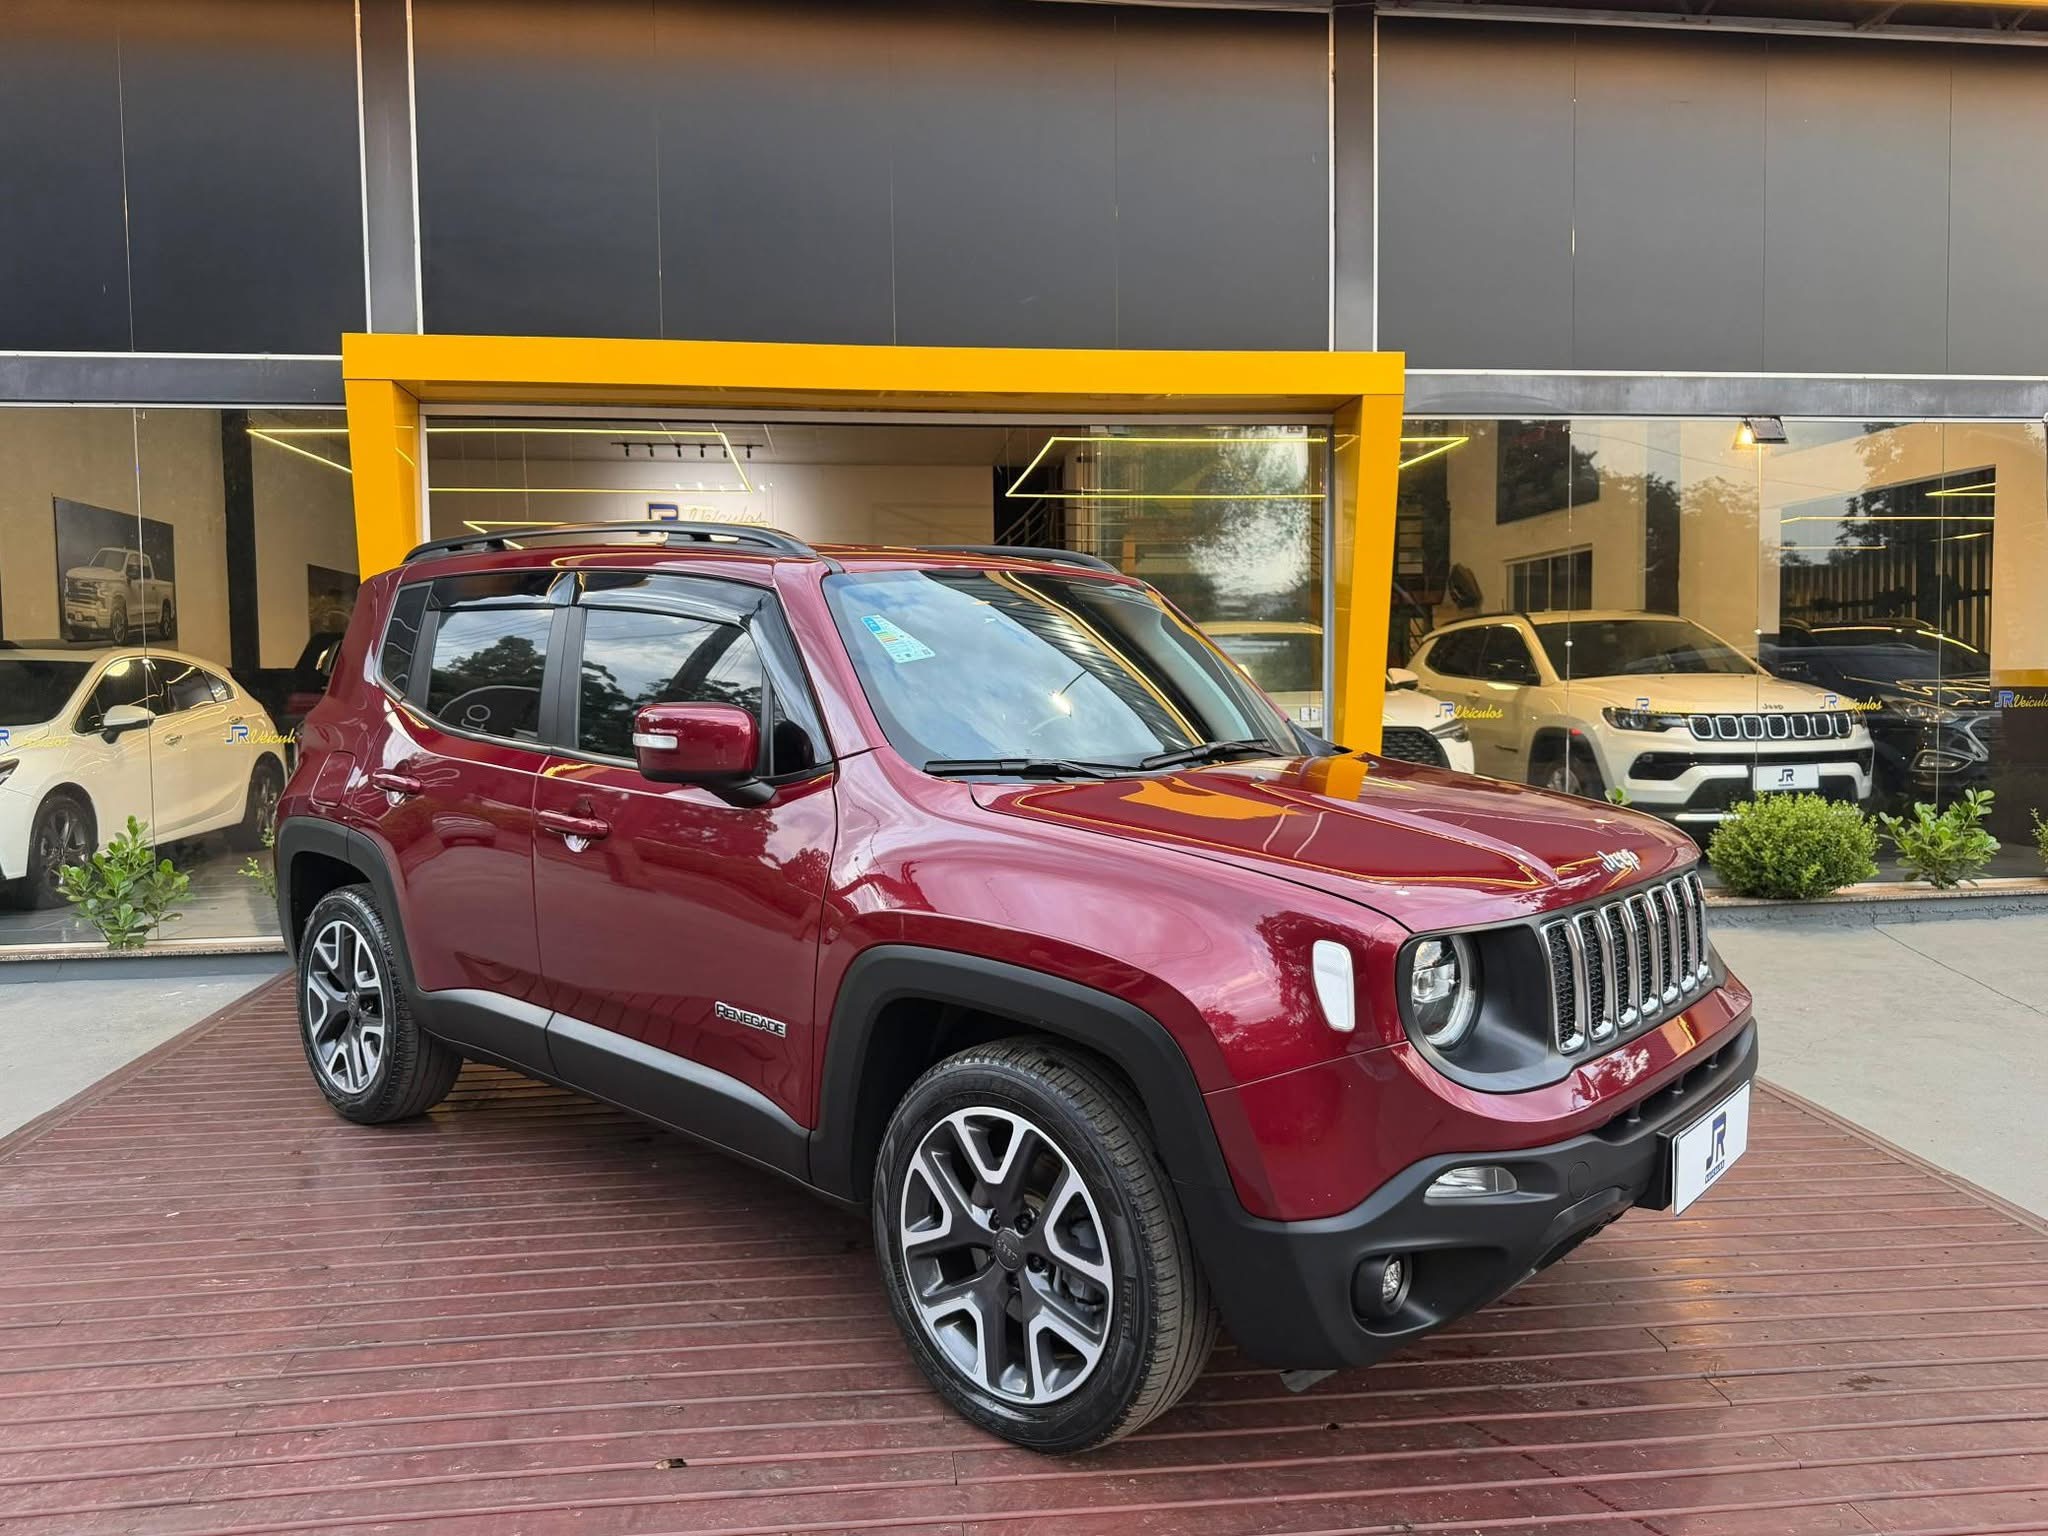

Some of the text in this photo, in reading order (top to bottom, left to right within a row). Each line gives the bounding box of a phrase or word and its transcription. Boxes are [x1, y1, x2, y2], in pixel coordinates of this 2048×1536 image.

[1819, 693, 1838, 709] JR
[1995, 690, 2014, 707] JR
[1435, 701, 1454, 719] JR
[225, 725, 249, 744] JR
[1778, 768, 1794, 782] JR
[1596, 848, 1641, 874] Jeep
[715, 1001, 787, 1038] RENEGADE
[1705, 1111, 1727, 1172] JR
